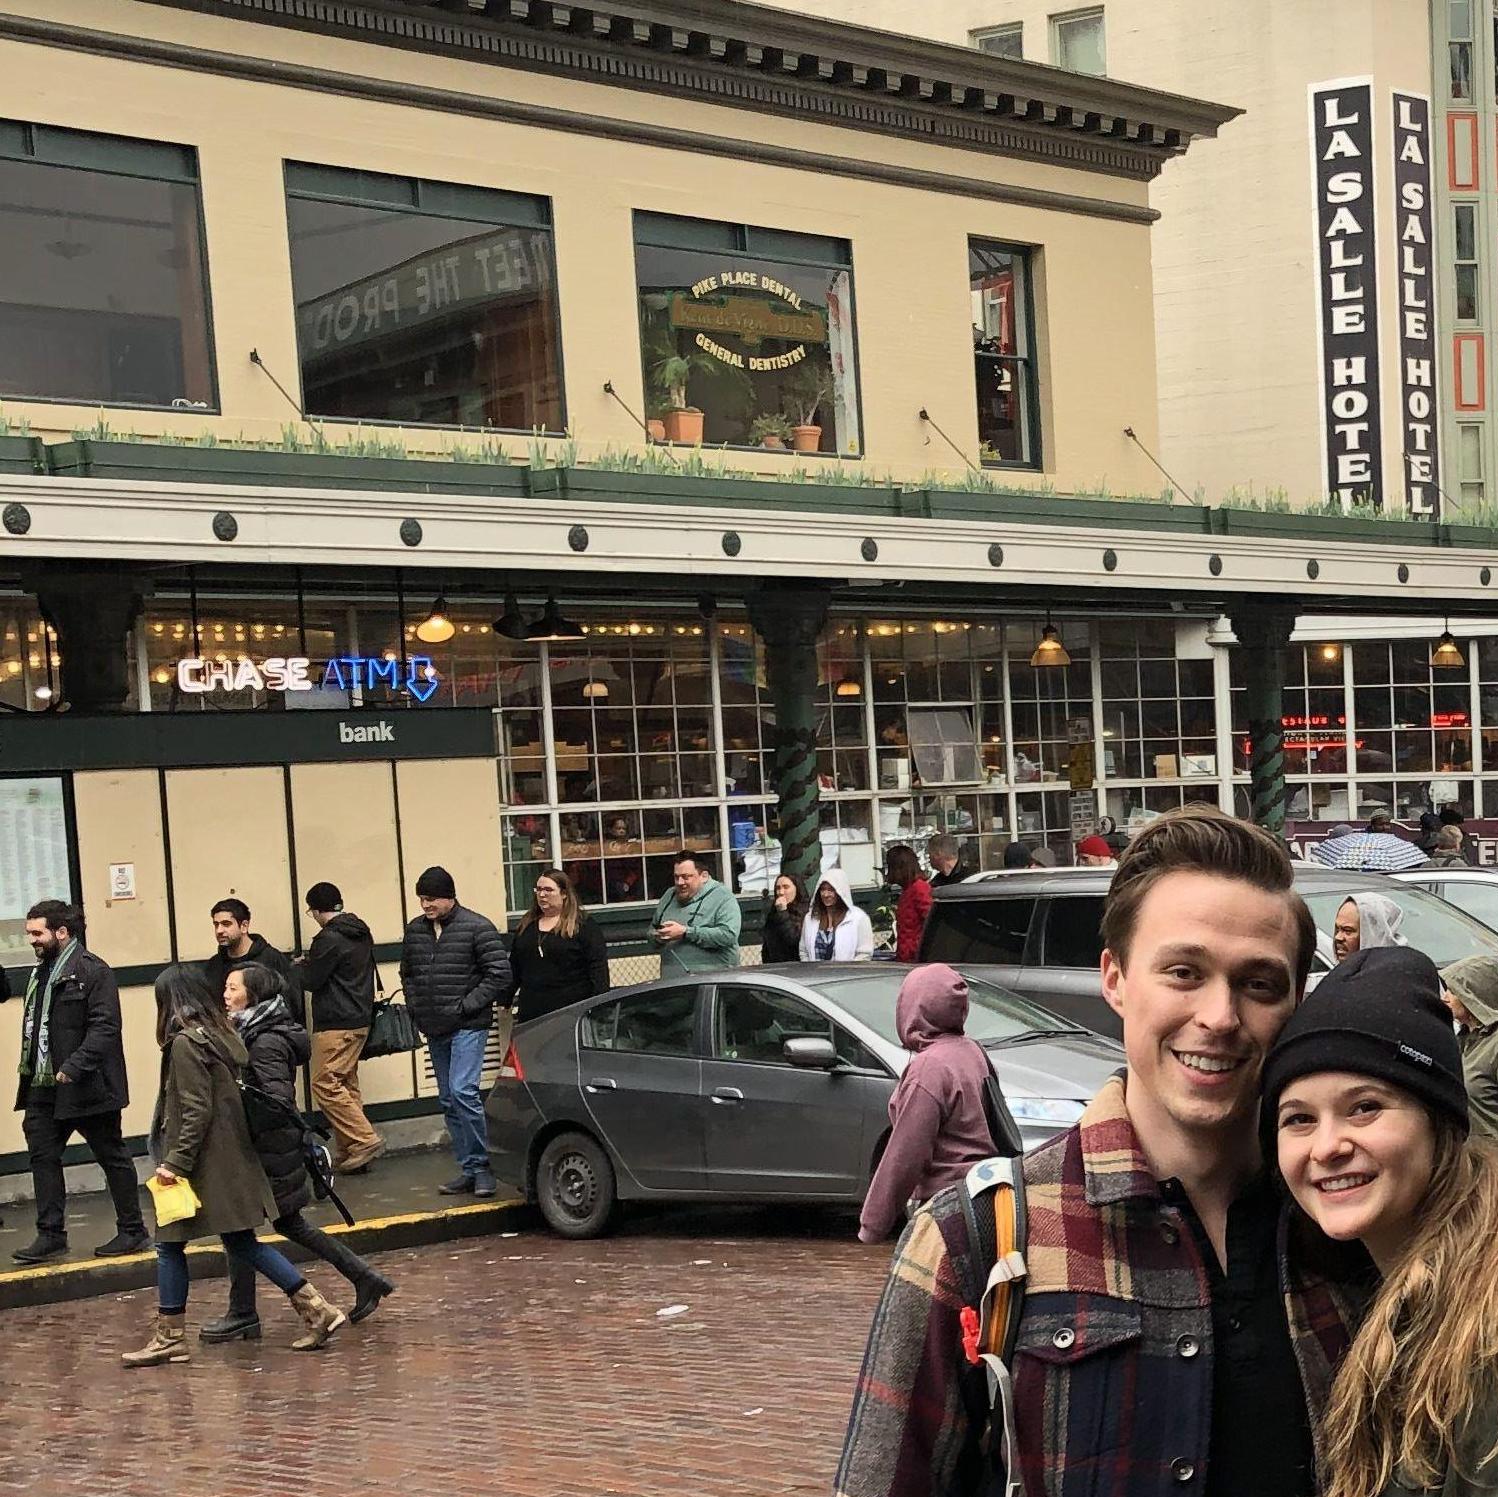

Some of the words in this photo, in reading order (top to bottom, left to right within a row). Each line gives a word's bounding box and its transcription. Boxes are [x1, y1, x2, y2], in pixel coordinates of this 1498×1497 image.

[1323, 98, 1362, 161] LA
[1399, 101, 1425, 165] LA
[1325, 171, 1365, 335] SALLE
[1402, 182, 1428, 341] SALLE
[691, 276, 719, 299] PIKE
[720, 271, 758, 286] PLACE
[761, 275, 802, 311] DENTAL
[695, 332, 745, 369] GENERAL
[749, 344, 807, 371] DENTISTRY
[1406, 358, 1434, 514] HOTEL
[177, 657, 312, 693] CHASE
[323, 657, 399, 691] ATM
[339, 721, 395, 744] bank
